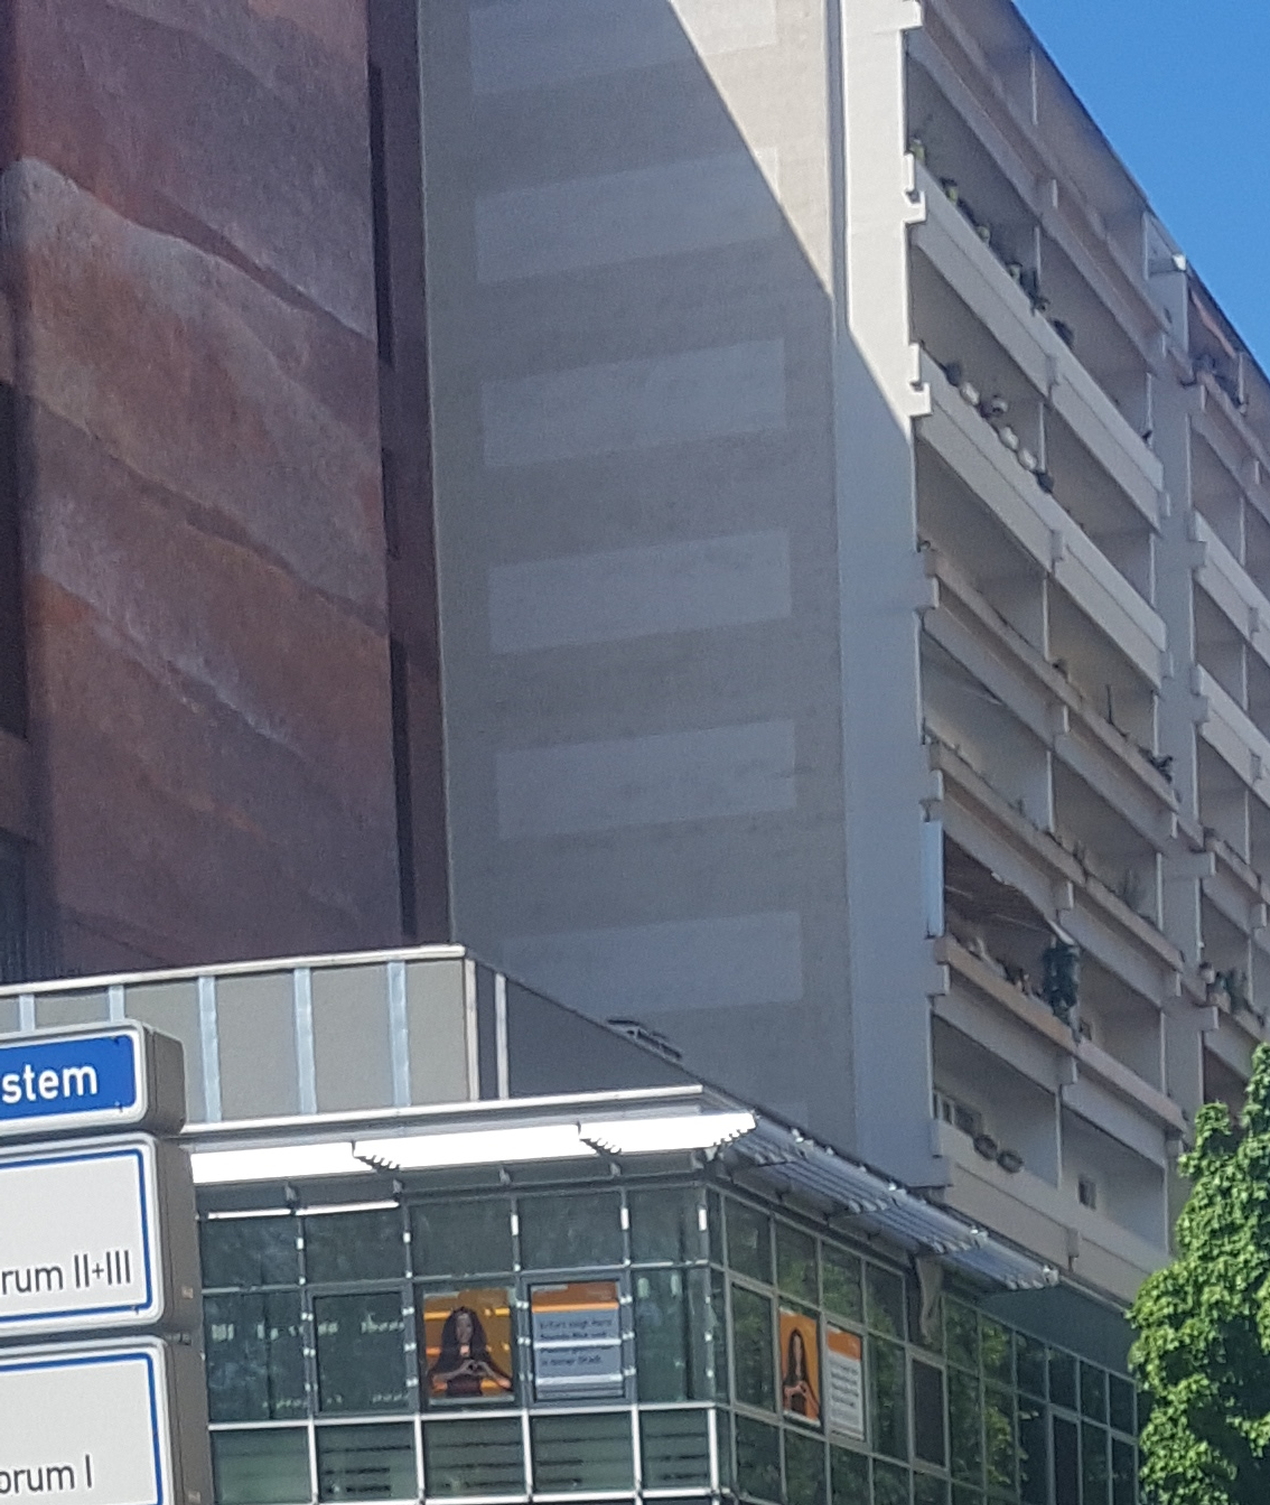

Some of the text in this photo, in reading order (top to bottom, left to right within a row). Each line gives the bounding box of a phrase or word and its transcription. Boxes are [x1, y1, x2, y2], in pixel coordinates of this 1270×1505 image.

[2, 1064, 98, 1104] stem
[1, 1265, 64, 1295] rum
[85, 1454, 92, 1489] I
